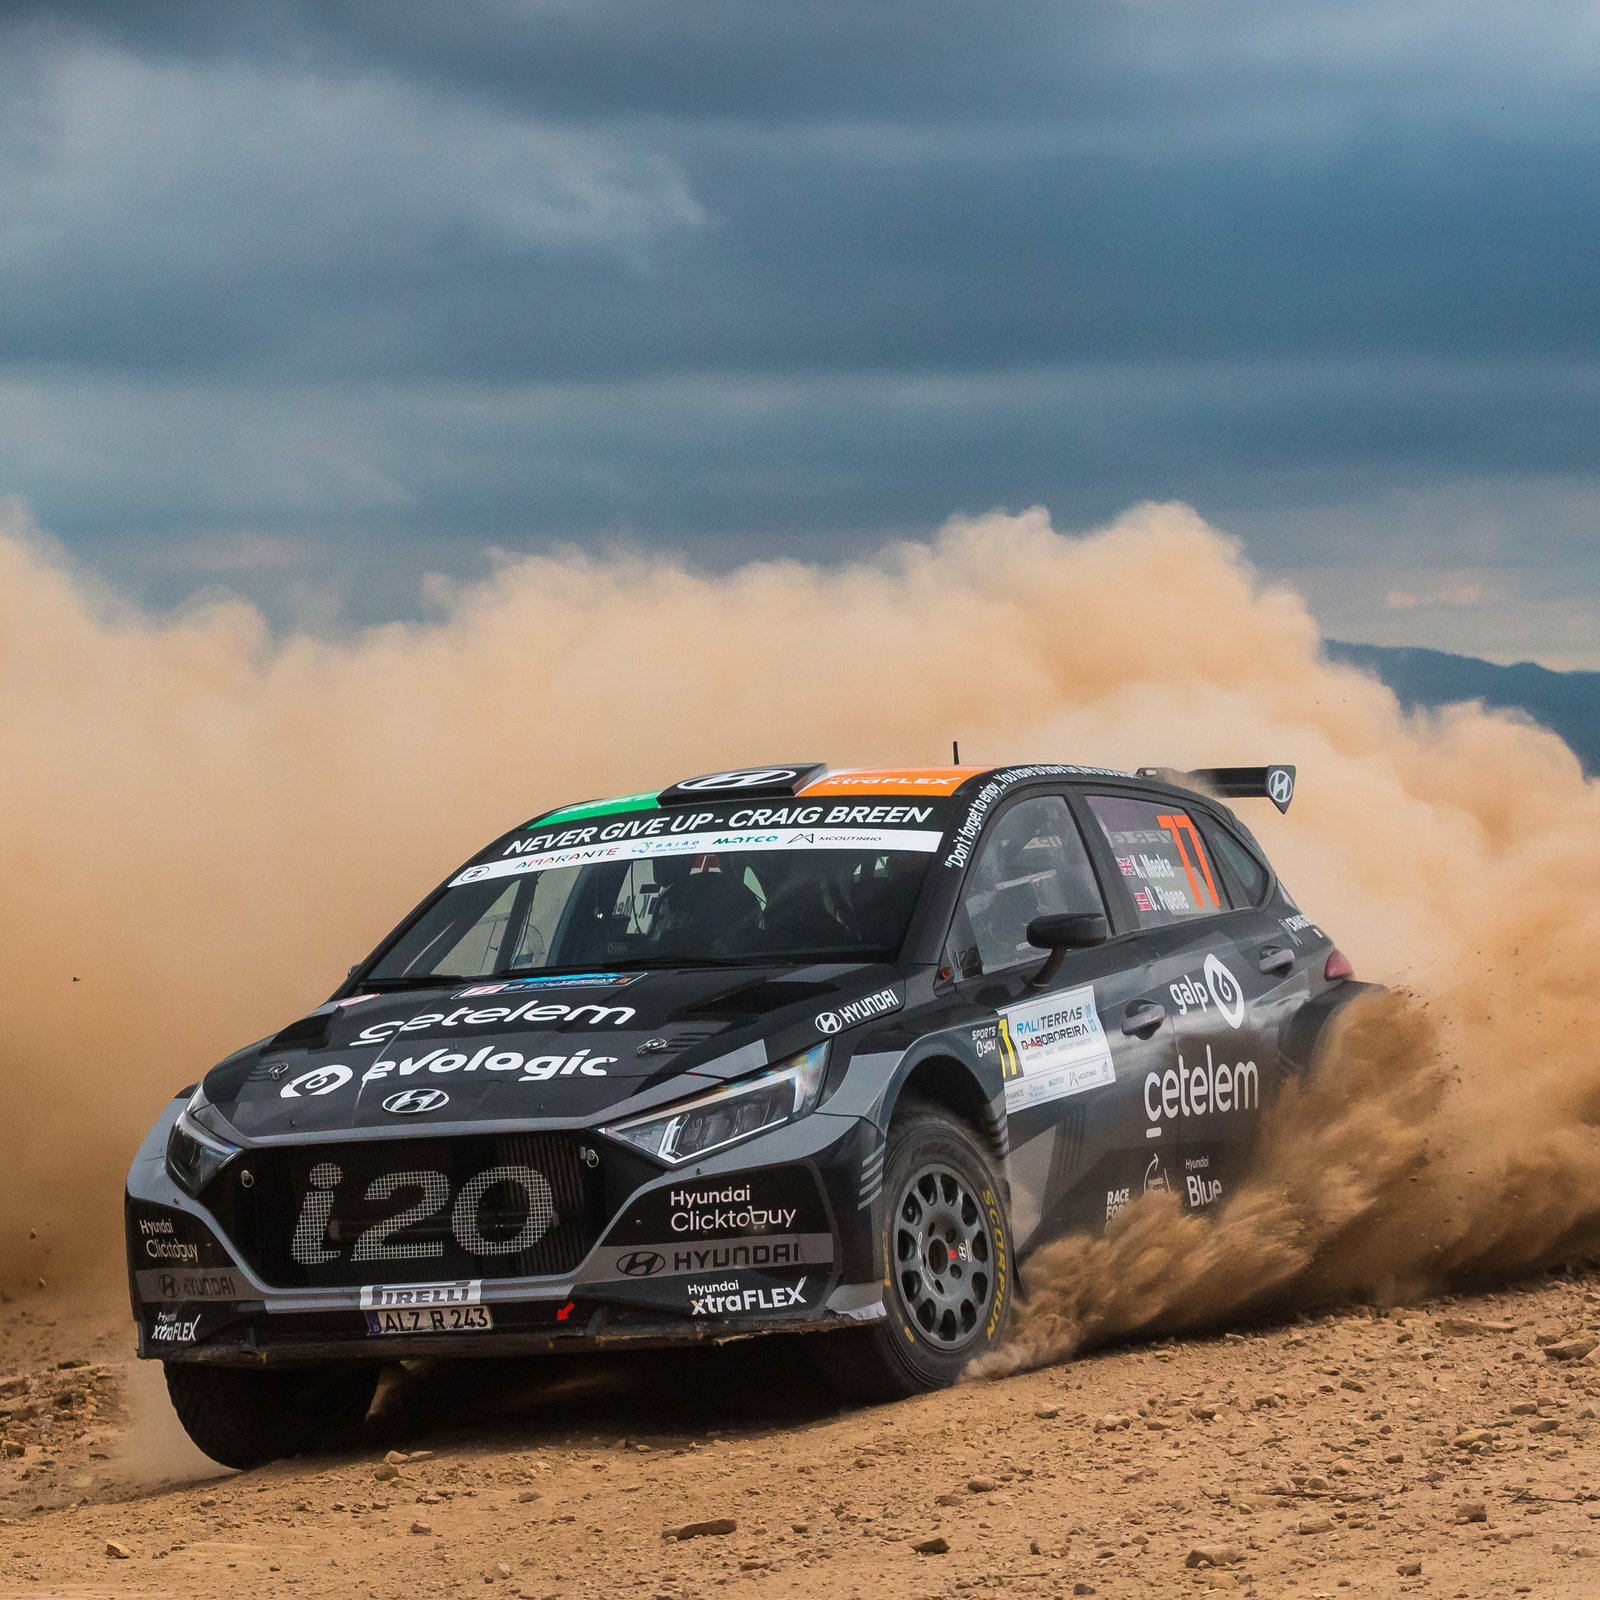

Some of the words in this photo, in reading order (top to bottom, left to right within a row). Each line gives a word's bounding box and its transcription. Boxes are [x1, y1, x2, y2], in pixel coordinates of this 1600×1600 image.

[503, 826, 598, 856] NEVER
[600, 816, 671, 841] GIVE
[728, 806, 824, 829] CRAIG
[824, 806, 934, 824] BREEN
[958, 808, 984, 839] forget
[971, 799, 988, 811] to
[514, 847, 620, 870] AMARANTE
[1156, 815, 1221, 907] 77
[839, 988, 900, 1024] HYUNDAI
[1169, 974, 1209, 1016] galp
[350, 1000, 636, 1045] cetelem
[971, 1026, 997, 1041] SPORTS
[362, 1045, 619, 1081] evologic
[1144, 1044, 1259, 1138] cetelem
[1185, 1155, 1210, 1172] Hyundai
[670, 1184, 751, 1209] Hyundai
[1106, 1188, 1130, 1206] RACE
[1186, 1174, 1223, 1208] Blue
[140, 1218, 174, 1236] Hyundai
[290, 1162, 554, 1266] i20
[671, 1205, 797, 1232] Clicktobuy
[674, 1243, 799, 1271] HYUNDAI
[371, 1281, 472, 1306] PIRELLI
[687, 1279, 739, 1296] Hyundai
[690, 1275, 807, 1316] xtraFLEX
[429, 1310, 447, 1331] R
[449, 1307, 488, 1329] 243
